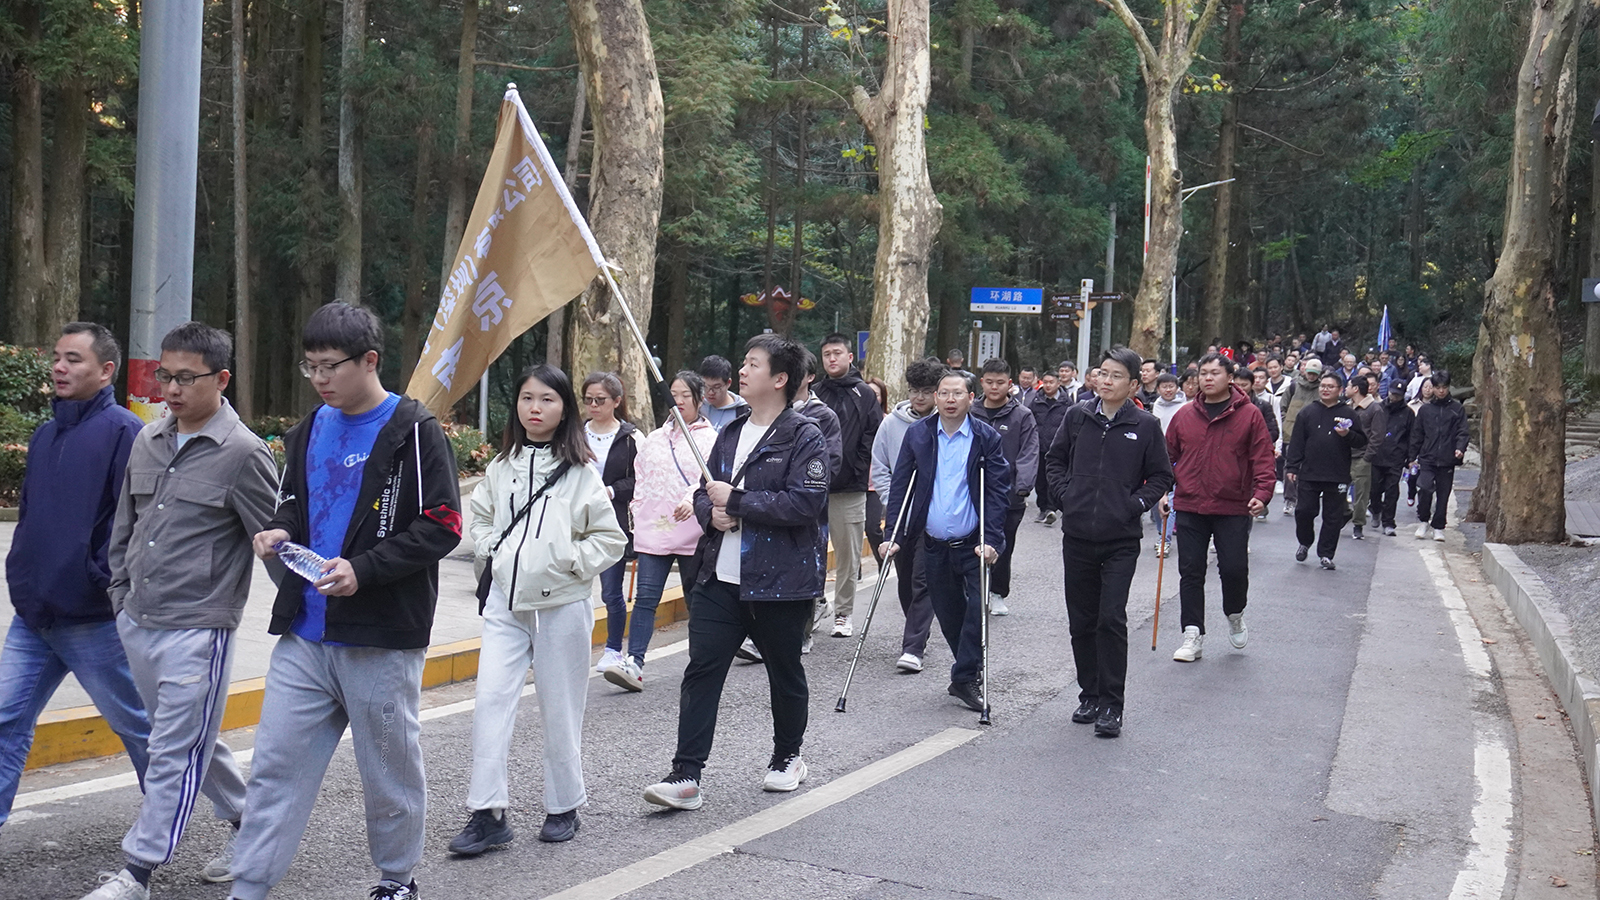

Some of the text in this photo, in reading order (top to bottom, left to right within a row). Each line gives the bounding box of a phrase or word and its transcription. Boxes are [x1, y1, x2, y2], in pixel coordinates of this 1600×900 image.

[990, 290, 1023, 302] 环湖路
[344, 452, 370, 468] Chi
